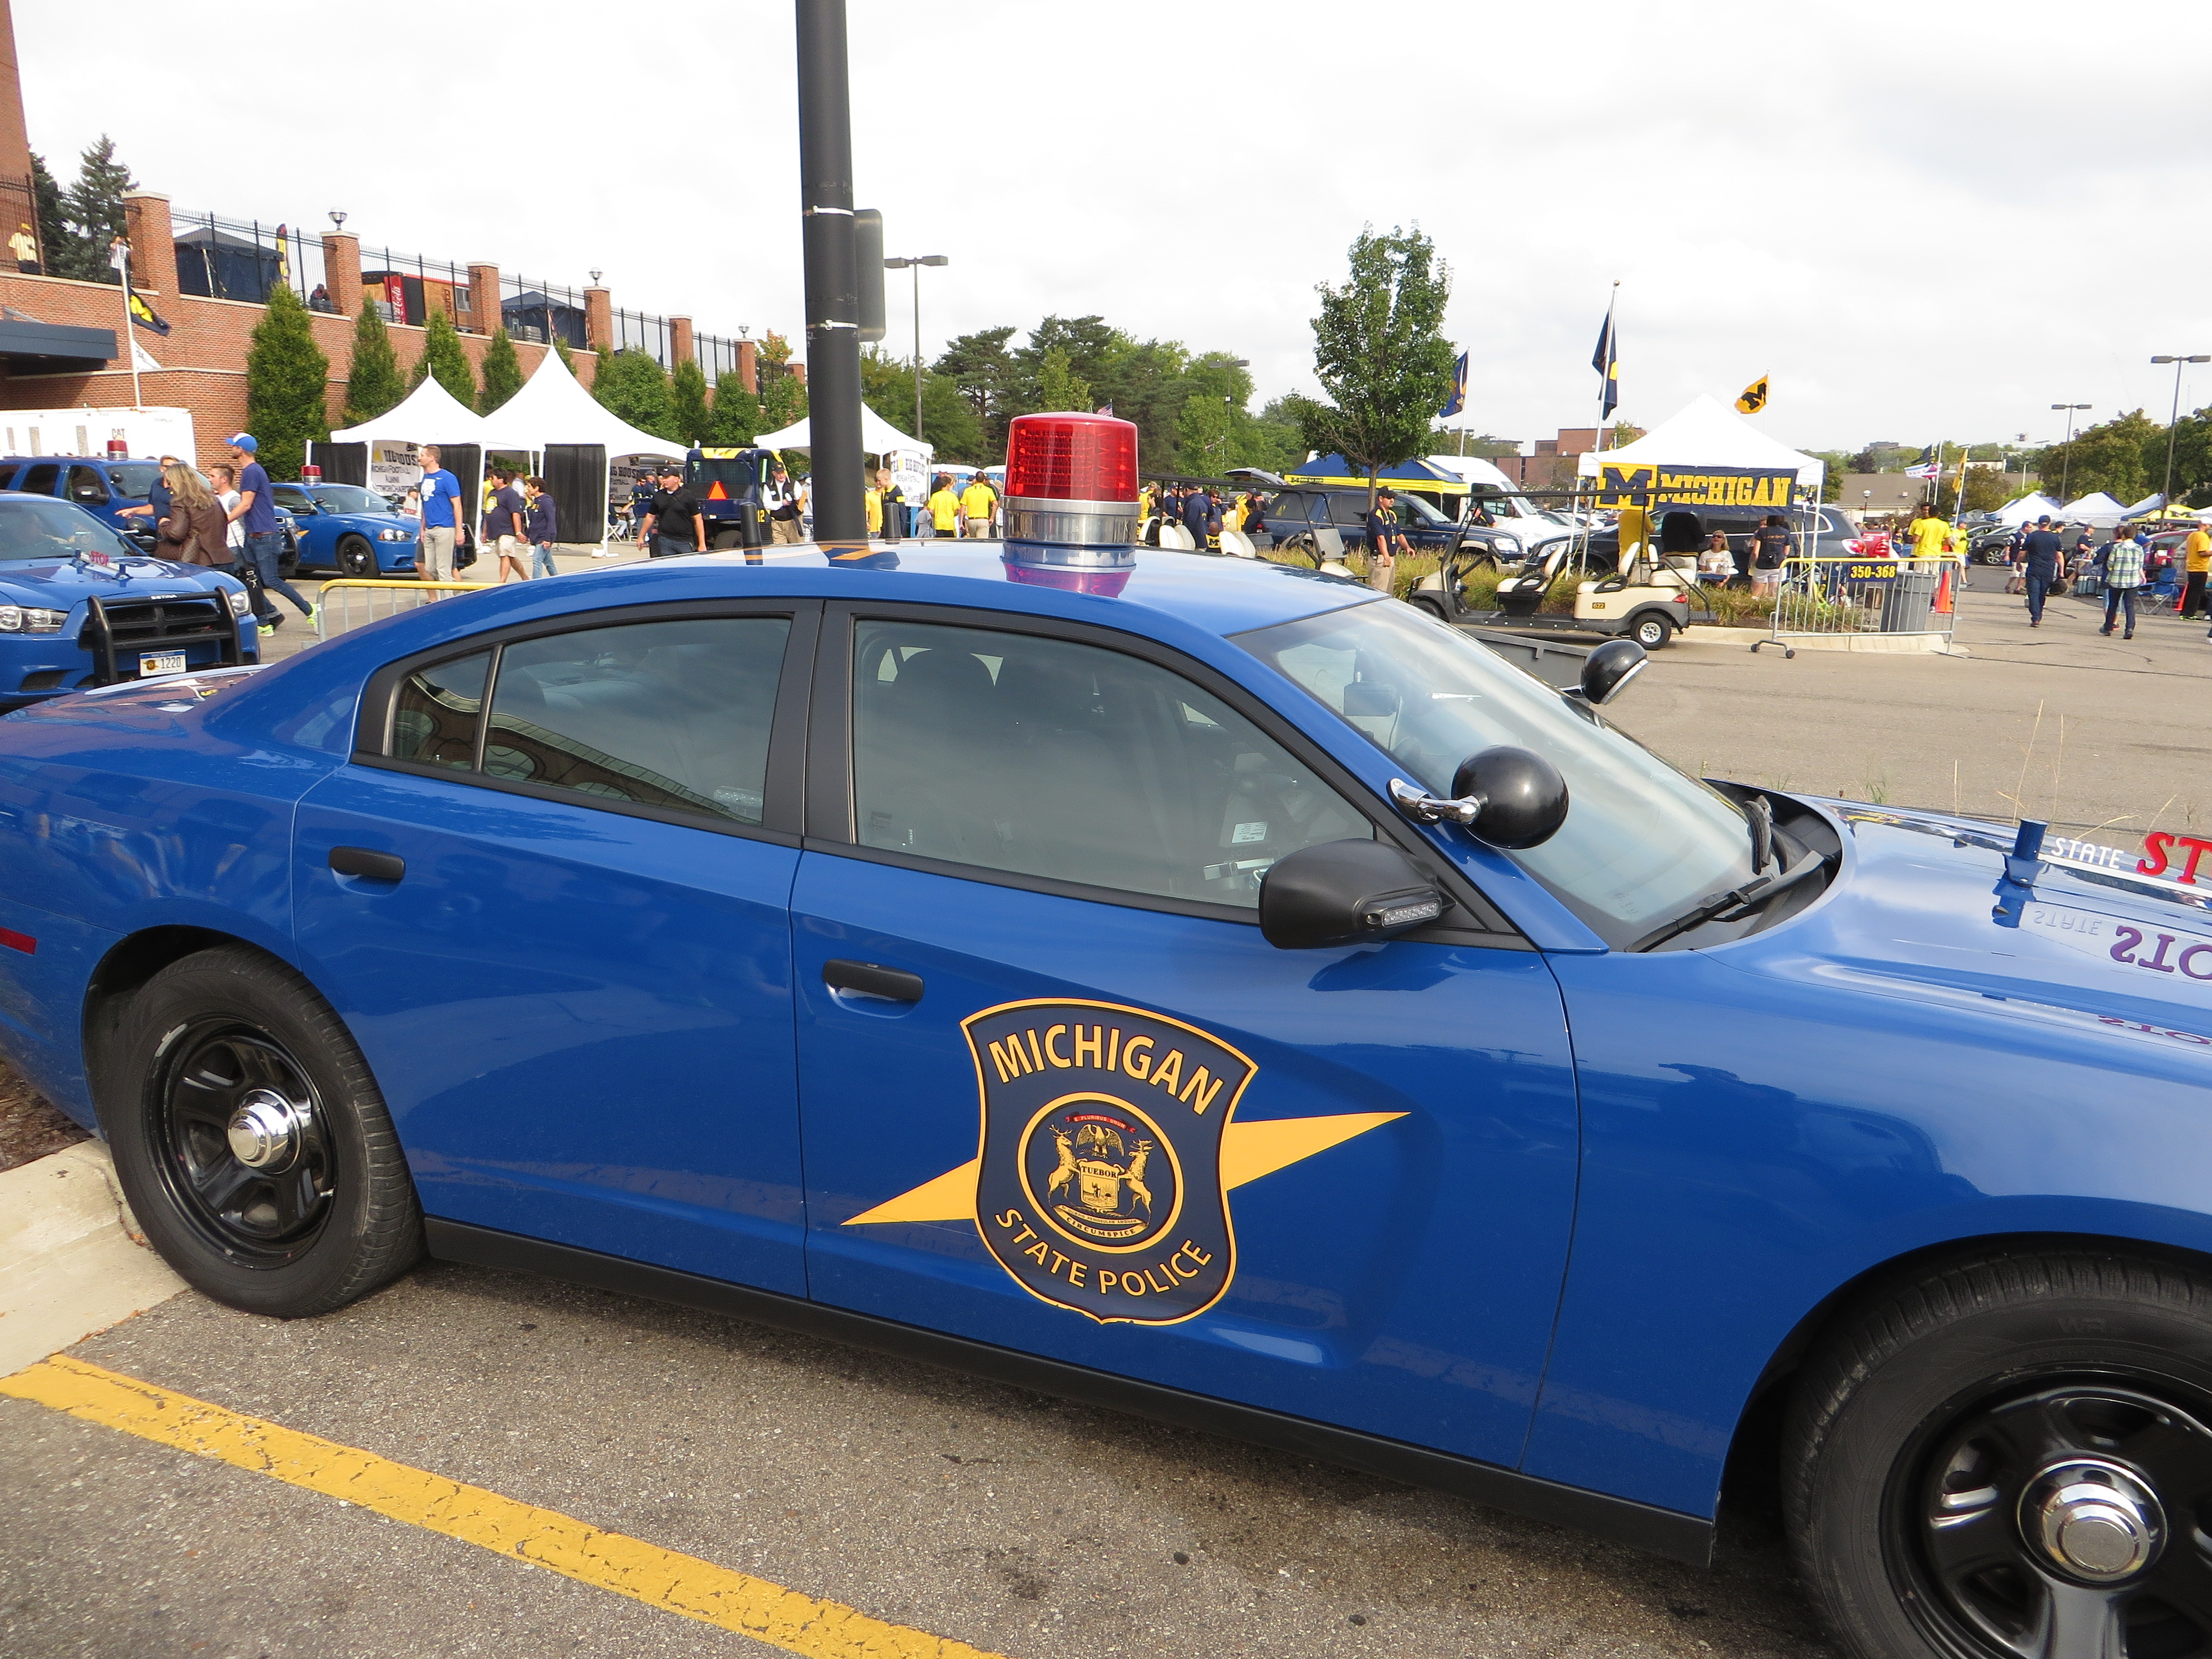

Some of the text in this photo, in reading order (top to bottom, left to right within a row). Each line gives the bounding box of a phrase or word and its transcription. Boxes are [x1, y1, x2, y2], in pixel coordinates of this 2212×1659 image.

[1741, 382, 1767, 410] M
[112, 429, 124, 440] CAT
[1599, 467, 1791, 507] M MICHIGAN
[1850, 565, 1896, 578] 350-368
[160, 656, 181, 669] 1220
[2051, 831, 2212, 884] STATE ST
[988, 1024, 1224, 1115] MICHIGAN
[1081, 1166, 1117, 1178] TUEBOR
[1066, 1217, 1135, 1237] CIRCUMSPICE
[995, 1208, 1214, 1297] STATE POLICE
